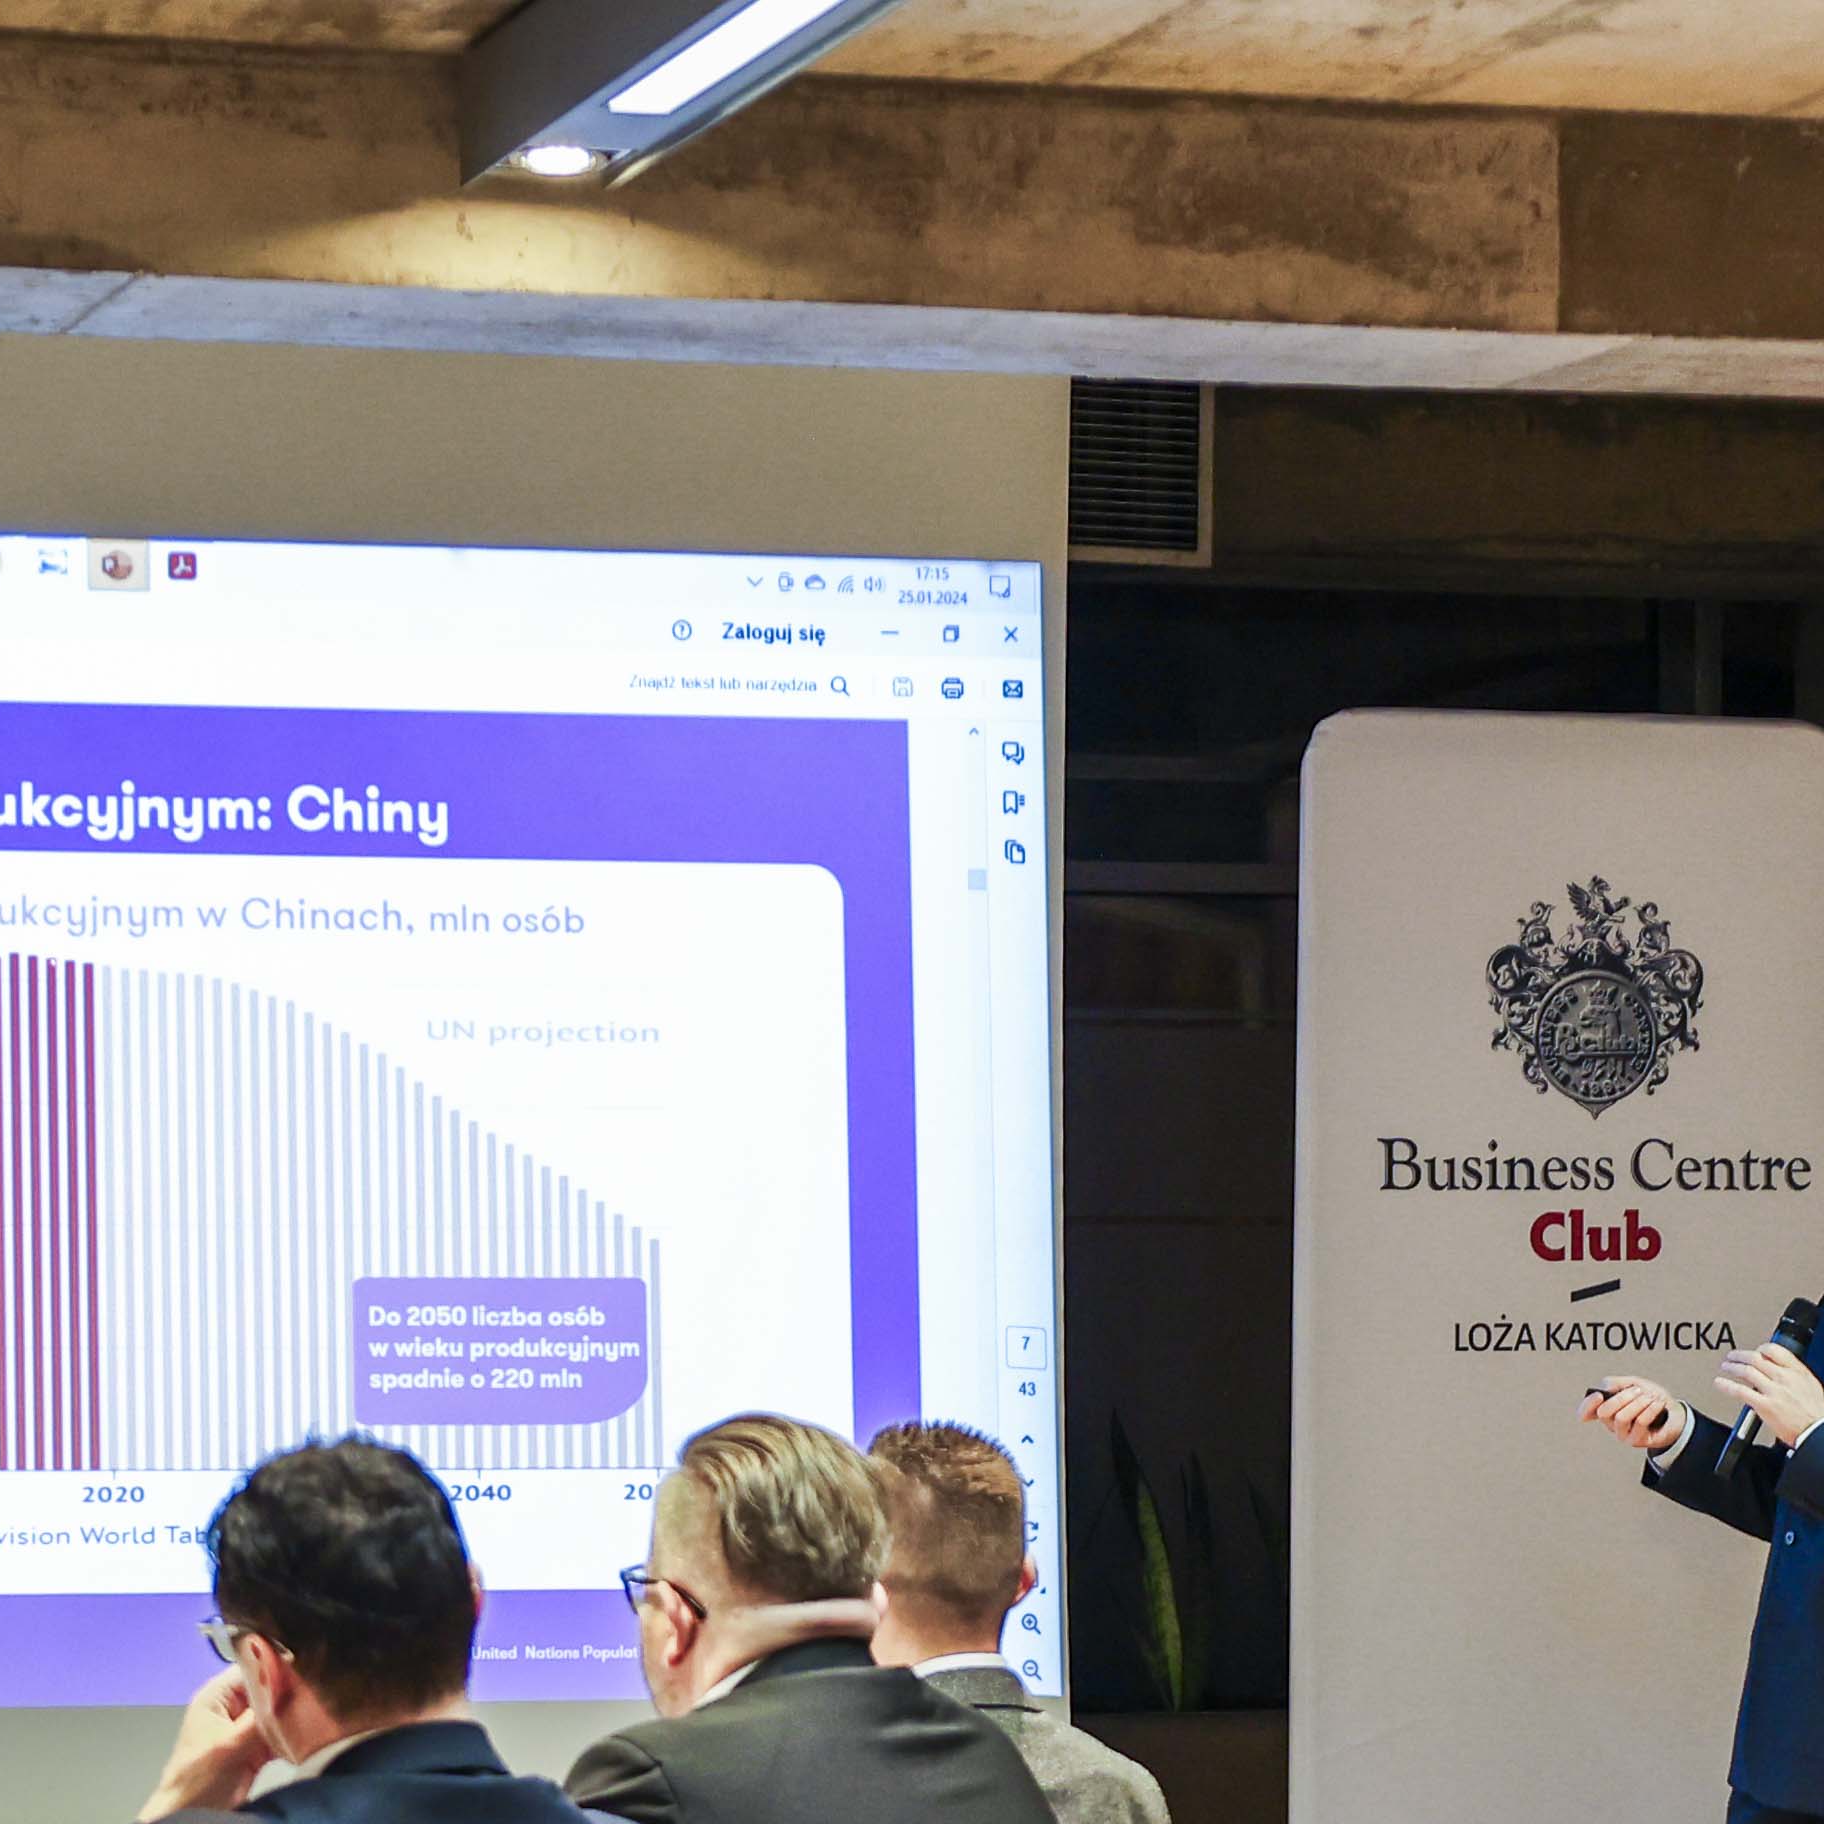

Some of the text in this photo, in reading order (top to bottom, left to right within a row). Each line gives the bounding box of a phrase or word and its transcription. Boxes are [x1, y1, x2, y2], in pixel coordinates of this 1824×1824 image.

[916, 566, 950, 581] 17:15
[898, 589, 969, 606] 25.01.2024
[722, 622, 826, 647] Zaloguj się
[719, 677, 741, 690] lub
[745, 678, 818, 694] narzędzia
[287, 784, 449, 847] Chiny
[196, 906, 227, 928] w
[241, 897, 415, 935] Chinach,
[429, 903, 490, 933] mln
[502, 905, 585, 934] osób
[427, 1019, 660, 1049] UN projection
[1376, 1137, 1812, 1192] Business Centre
[1529, 1208, 1662, 1262] Club
[368, 1304, 606, 1327] Do 2050 liczba osób
[1021, 1335, 1031, 1350] 7
[1454, 1313, 1737, 1352] LOŻA KATOWICKA
[367, 1334, 641, 1363] w wieku produkcyjnym
[369, 1367, 583, 1395] spadnie o 220 mln
[1018, 1381, 1037, 1397] 43
[82, 1486, 145, 1503] 2020
[450, 1483, 512, 1502] 2040
[623, 1483, 653, 1501] 20
[79, 1526, 156, 1545] World
[524, 1644, 580, 1660] Nations
[582, 1644, 642, 1663] Populat
